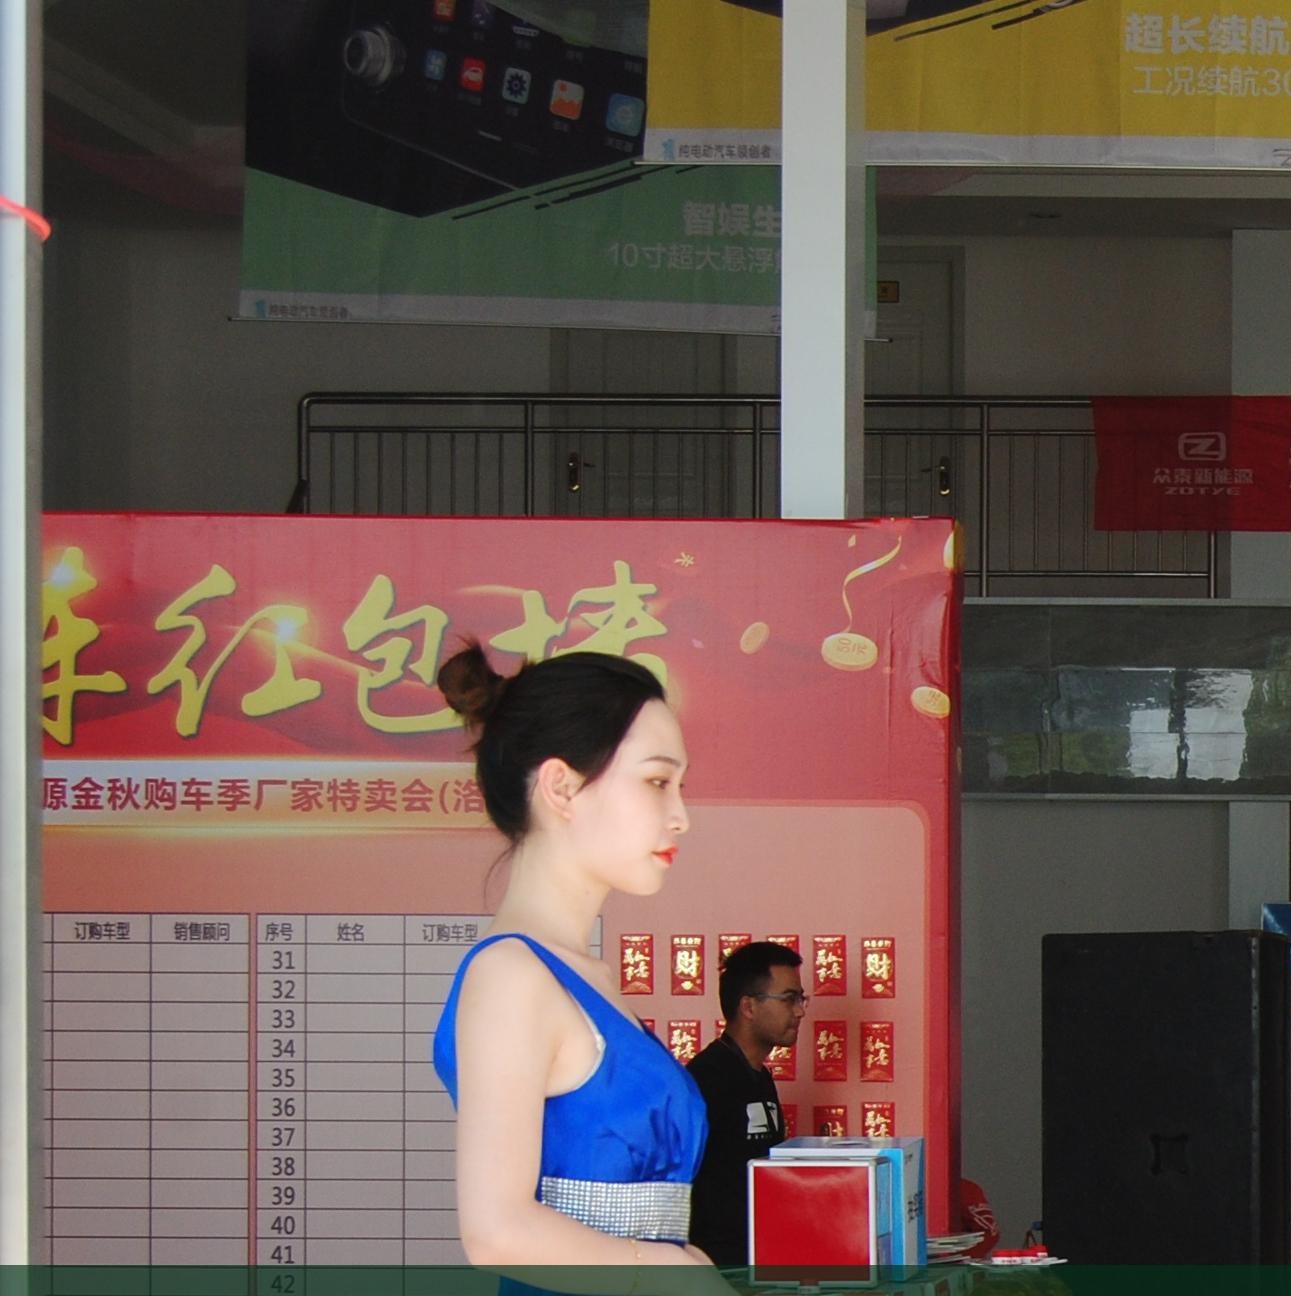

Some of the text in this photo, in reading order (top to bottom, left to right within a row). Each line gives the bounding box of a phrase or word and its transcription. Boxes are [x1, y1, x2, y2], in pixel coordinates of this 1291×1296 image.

[608, 243, 782, 274] 10寸超大悬浮
[1152, 468, 1254, 484] 众泰新能源
[74, 921, 231, 942] 订购车型 销售顾问
[264, 923, 478, 943] 序号 姓名 订购车型
[270, 952, 297, 972] 31
[270, 981, 297, 1001] 32
[270, 1010, 297, 1030] 33
[270, 1040, 297, 1060] 34
[270, 1069, 297, 1089] 35
[270, 1099, 297, 1119] 36
[270, 1128, 297, 1148] 37
[270, 1158, 297, 1178] 38
[270, 1187, 297, 1207] 39
[270, 1216, 297, 1236] 40
[270, 1246, 297, 1266] 41
[270, 1275, 297, 1295] 42
